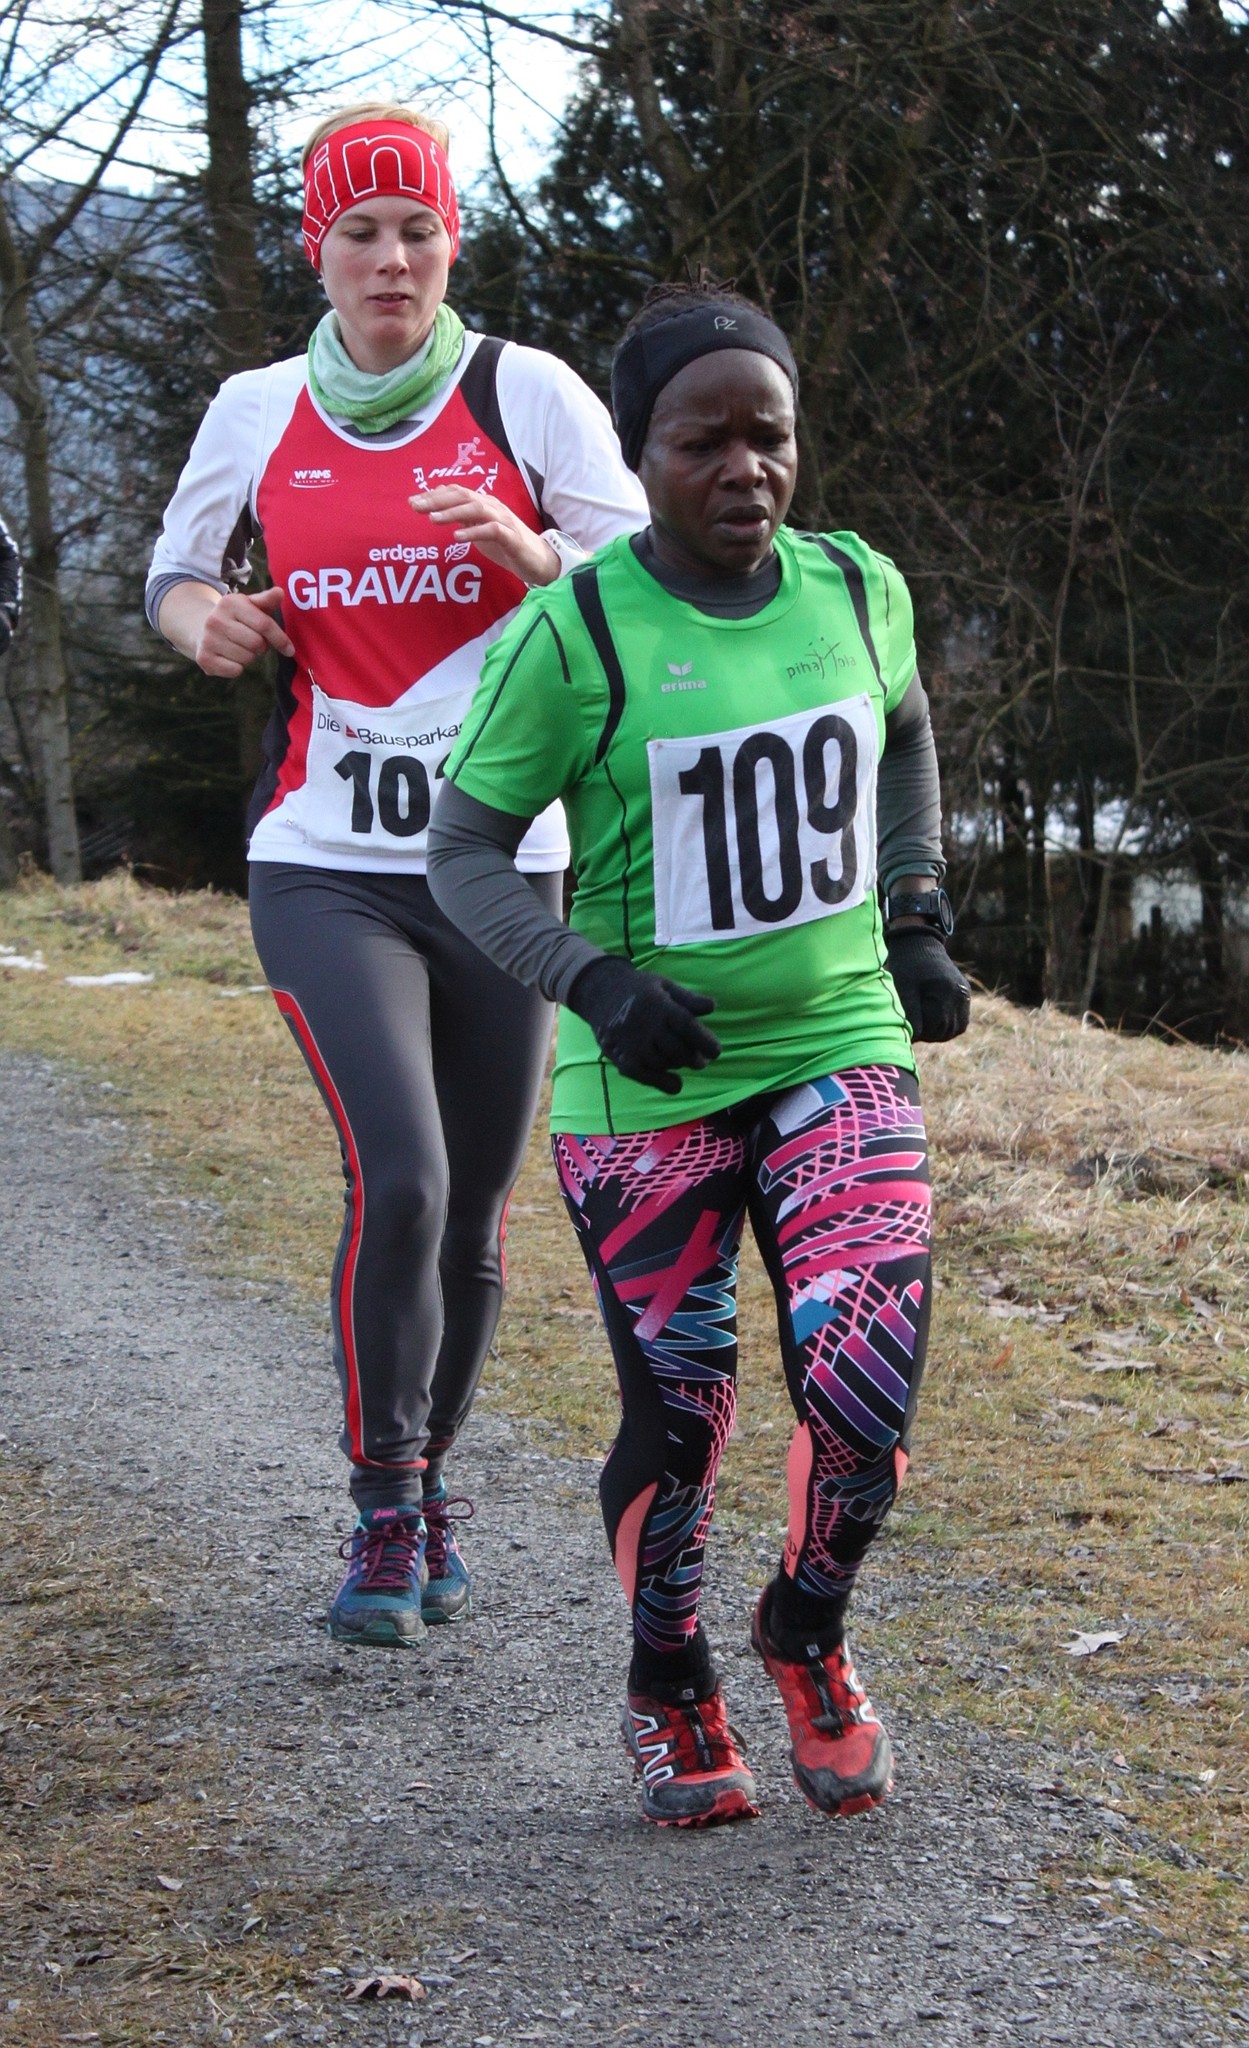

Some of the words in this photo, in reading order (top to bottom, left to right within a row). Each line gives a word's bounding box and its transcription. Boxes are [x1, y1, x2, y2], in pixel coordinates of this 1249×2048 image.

[369, 544, 439, 564] erdgas
[288, 563, 482, 611] GRAVAG
[661, 679, 707, 693] erima
[317, 713, 341, 732] Die
[333, 751, 451, 838] 10
[678, 714, 858, 930] 109
